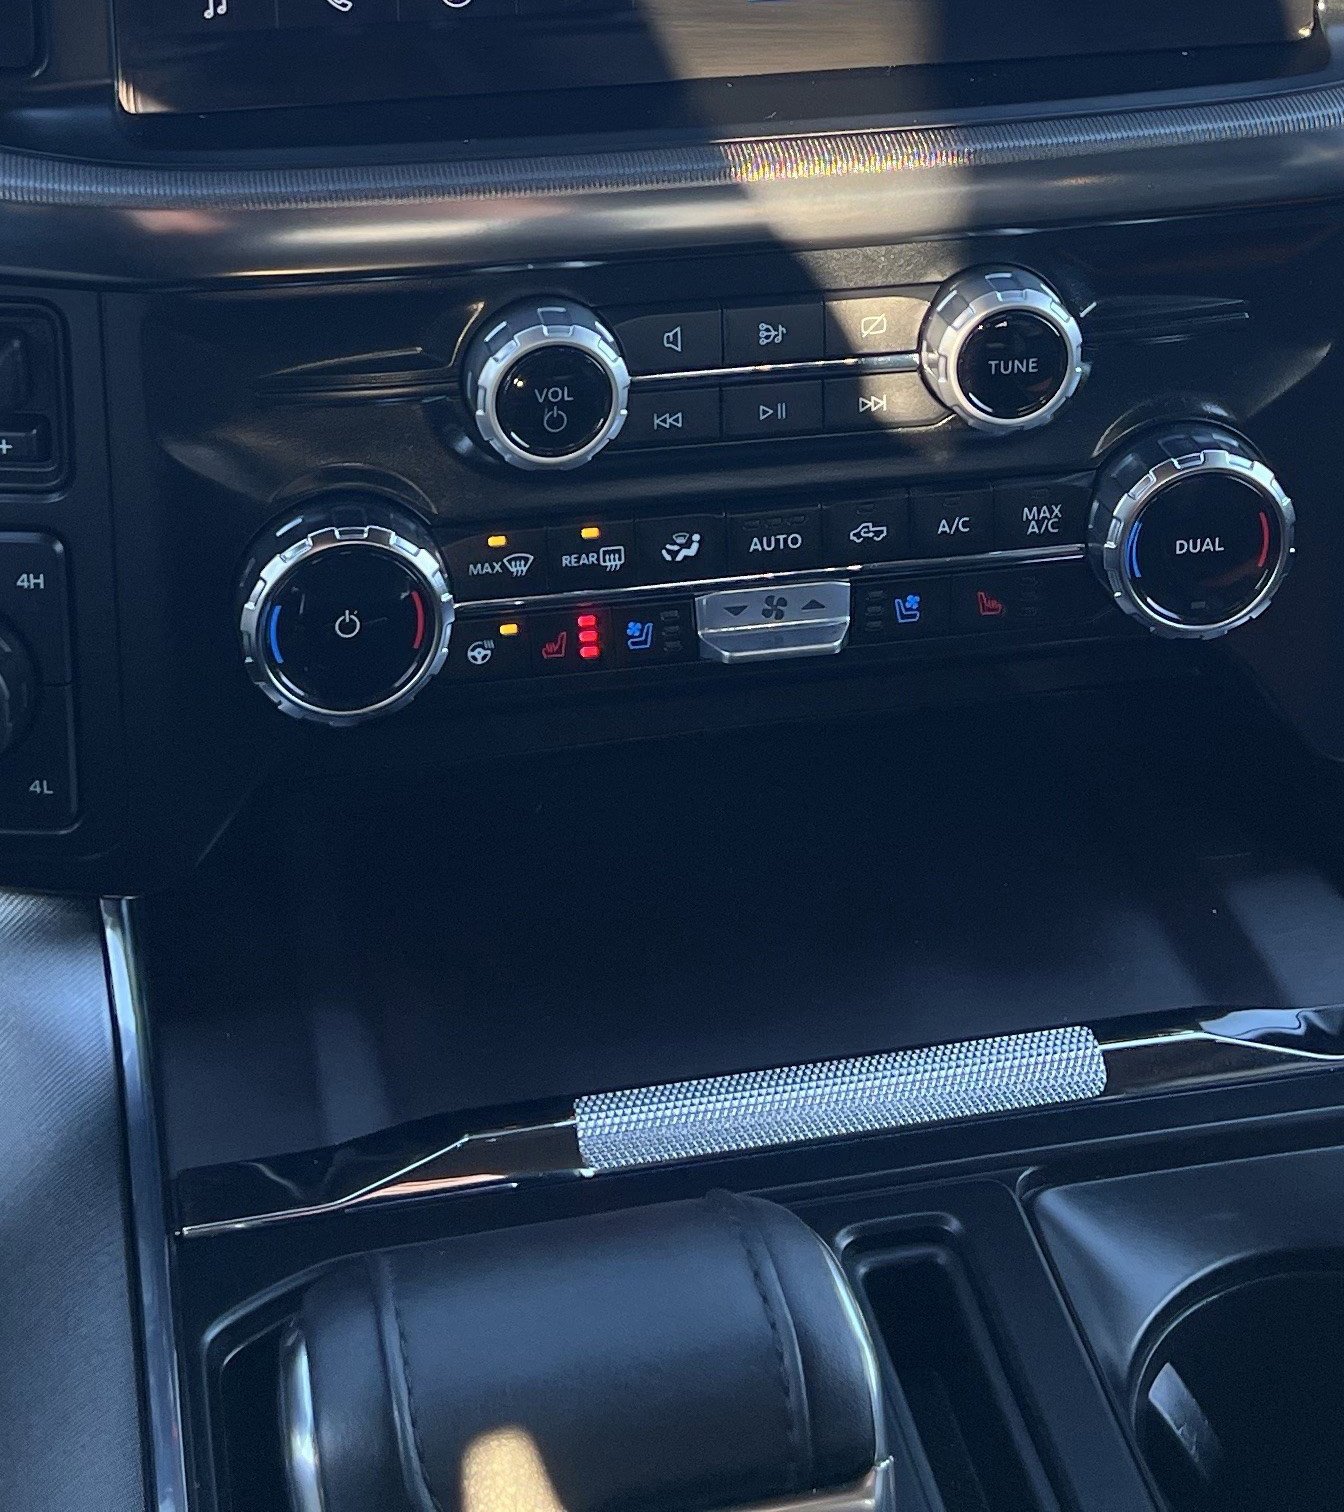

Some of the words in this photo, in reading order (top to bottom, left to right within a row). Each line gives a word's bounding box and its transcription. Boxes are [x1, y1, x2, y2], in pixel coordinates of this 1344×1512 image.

[988, 357, 1039, 374] TUNE
[535, 387, 574, 404] VOL
[1022, 504, 1062, 522] MAX
[937, 515, 971, 536] A/C
[1026, 517, 1060, 536] A/C
[748, 532, 803, 554] AUTO
[1175, 536, 1225, 555] DUAL
[562, 550, 598, 568] REAR
[469, 560, 503, 577] MAX
[16, 572, 45, 591] 4H
[29, 780, 54, 795] 4L
